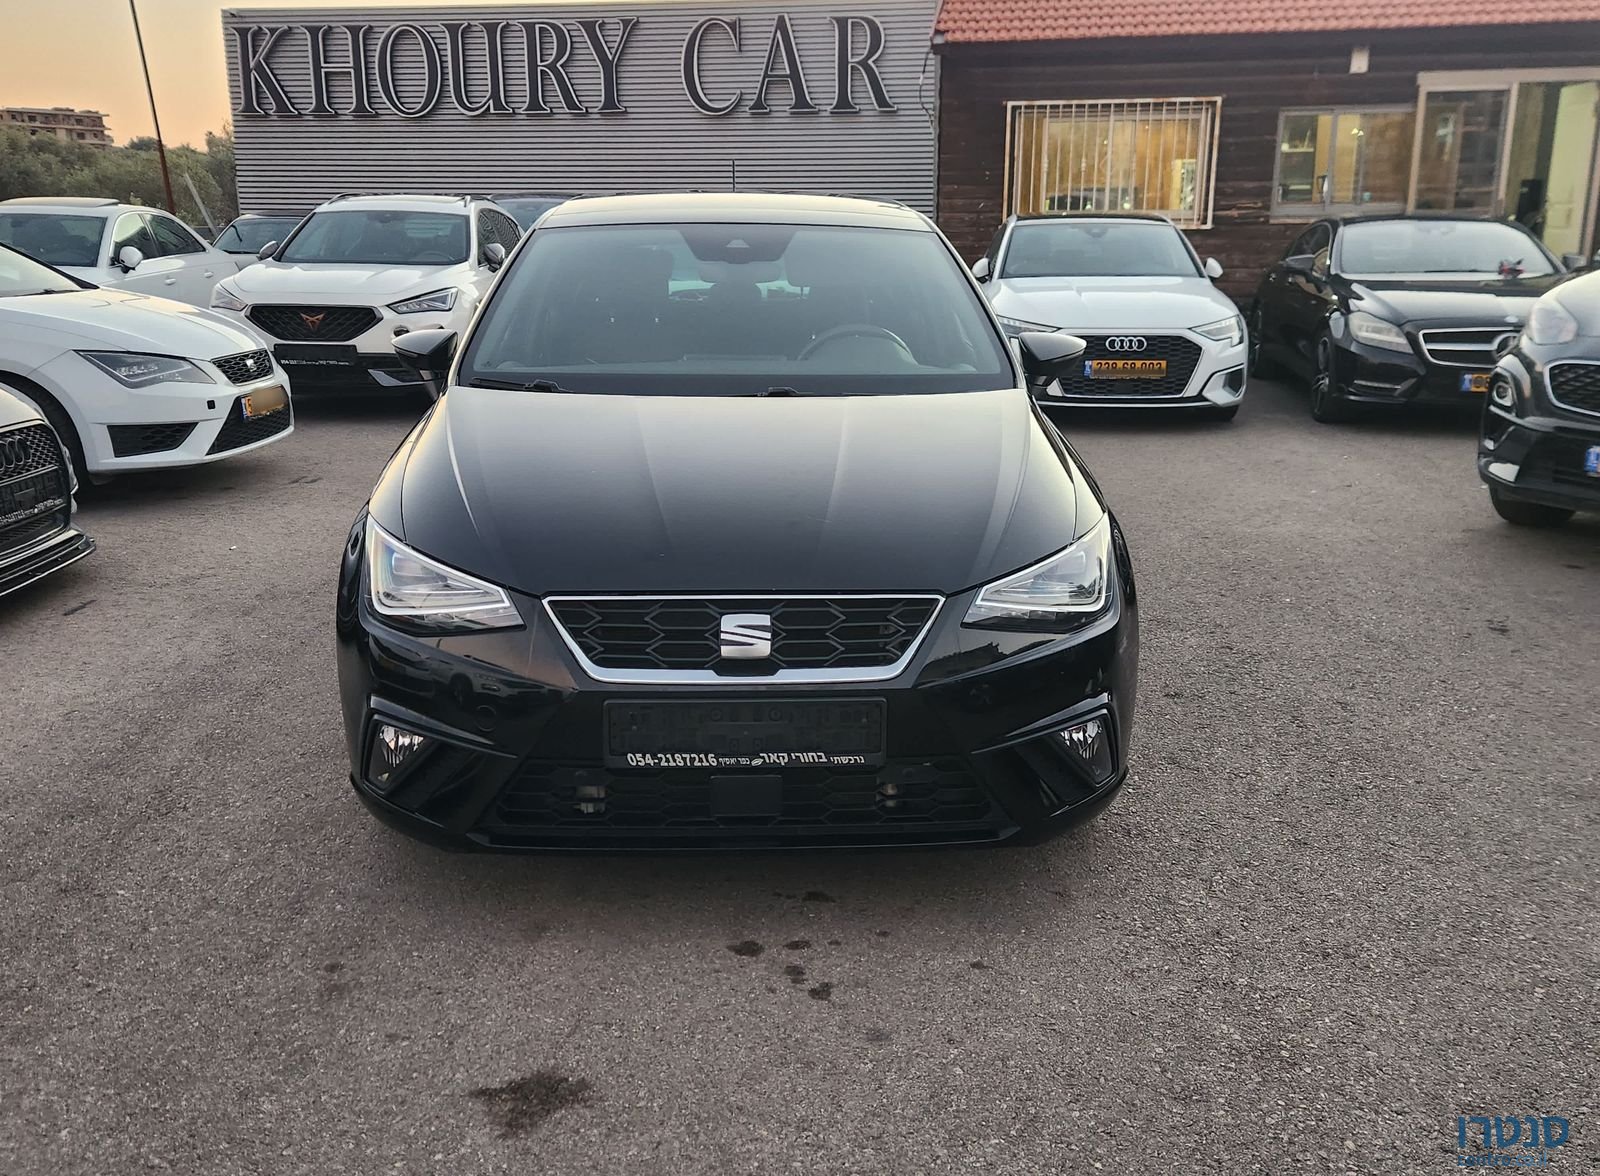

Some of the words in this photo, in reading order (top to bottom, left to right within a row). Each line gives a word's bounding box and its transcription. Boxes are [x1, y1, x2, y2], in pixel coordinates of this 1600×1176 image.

[230, 16, 639, 118] KHOURY
[681, 13, 897, 115] CAR
[627, 752, 718, 767] 054-2187216
